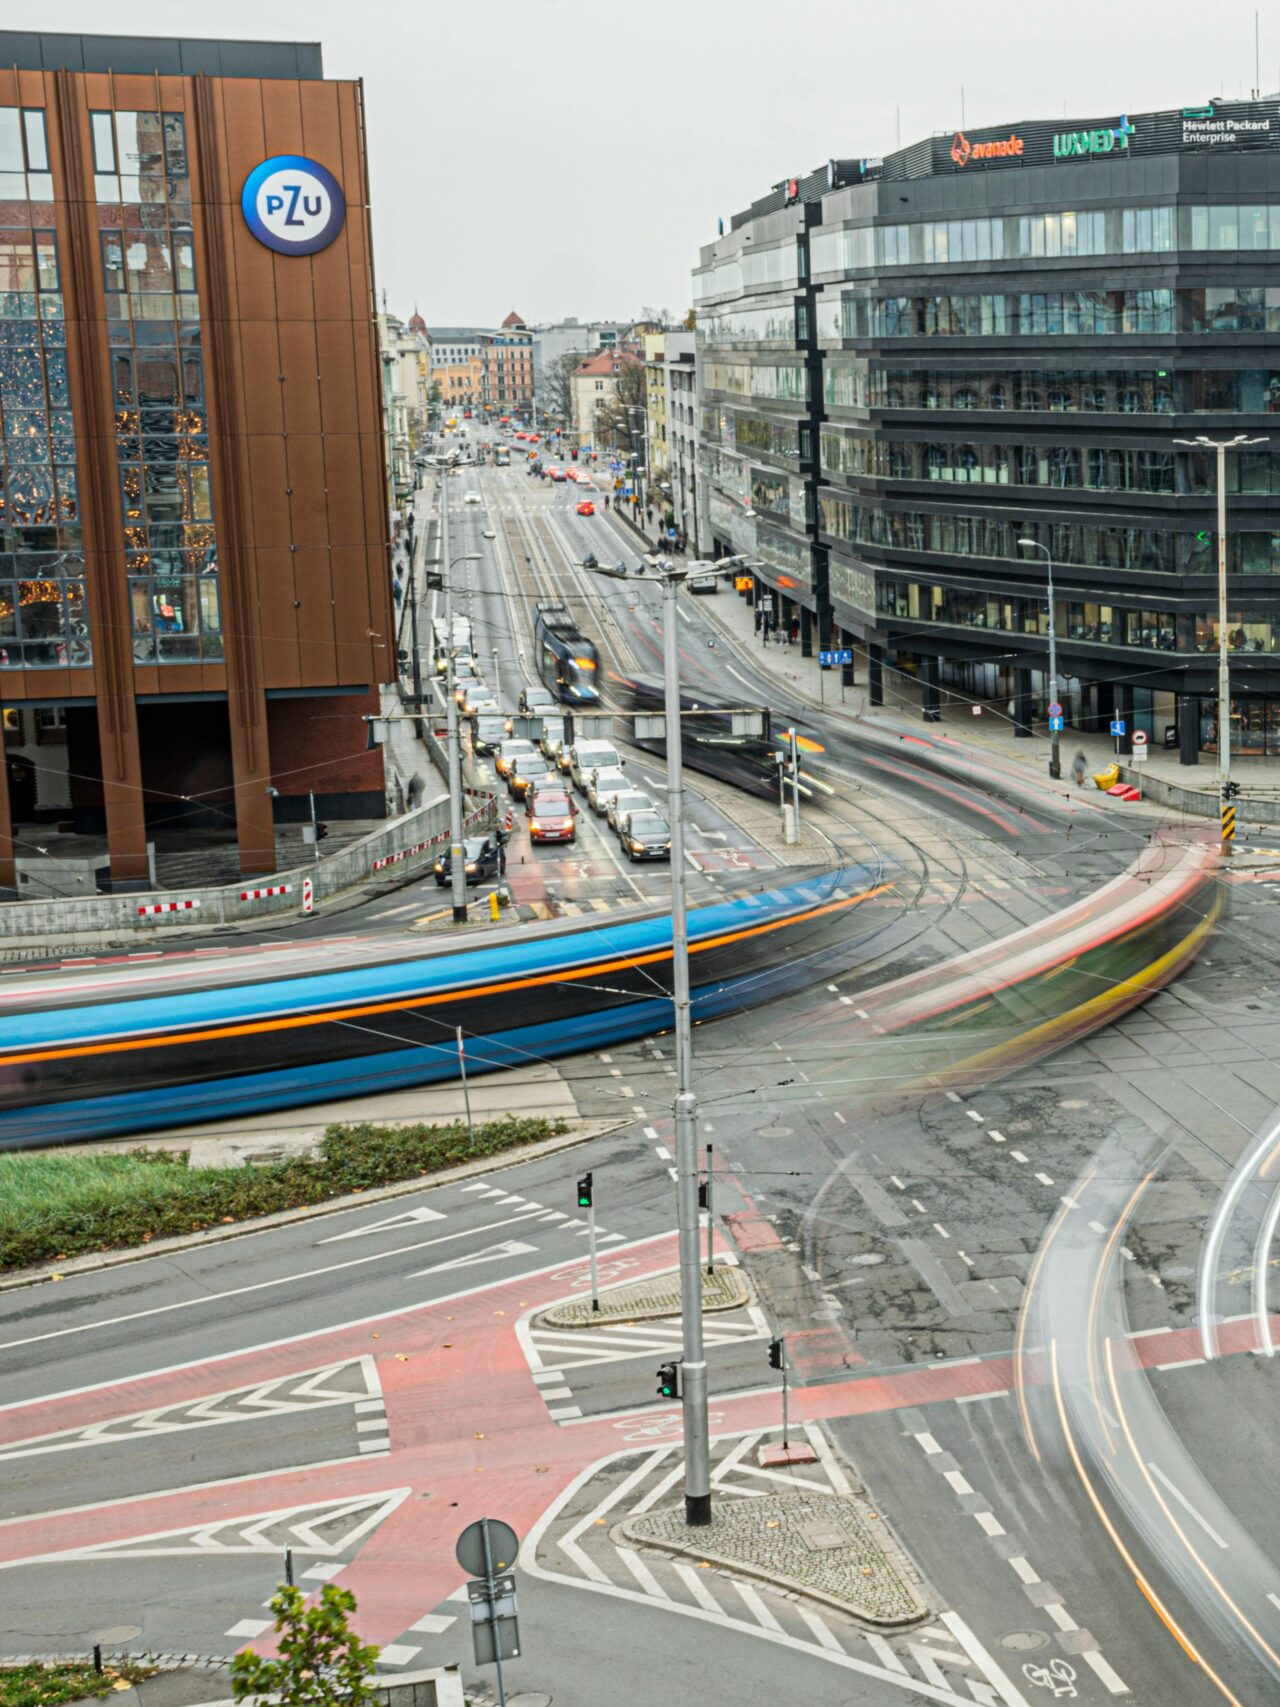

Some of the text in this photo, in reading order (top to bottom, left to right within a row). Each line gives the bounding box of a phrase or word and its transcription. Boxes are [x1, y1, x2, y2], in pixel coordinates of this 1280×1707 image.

[1183, 119, 1270, 131] Hewlett Packard
[972, 134, 1024, 159] avanade
[1183, 132, 1236, 144] Enterprise
[265, 185, 323, 226] PZU
